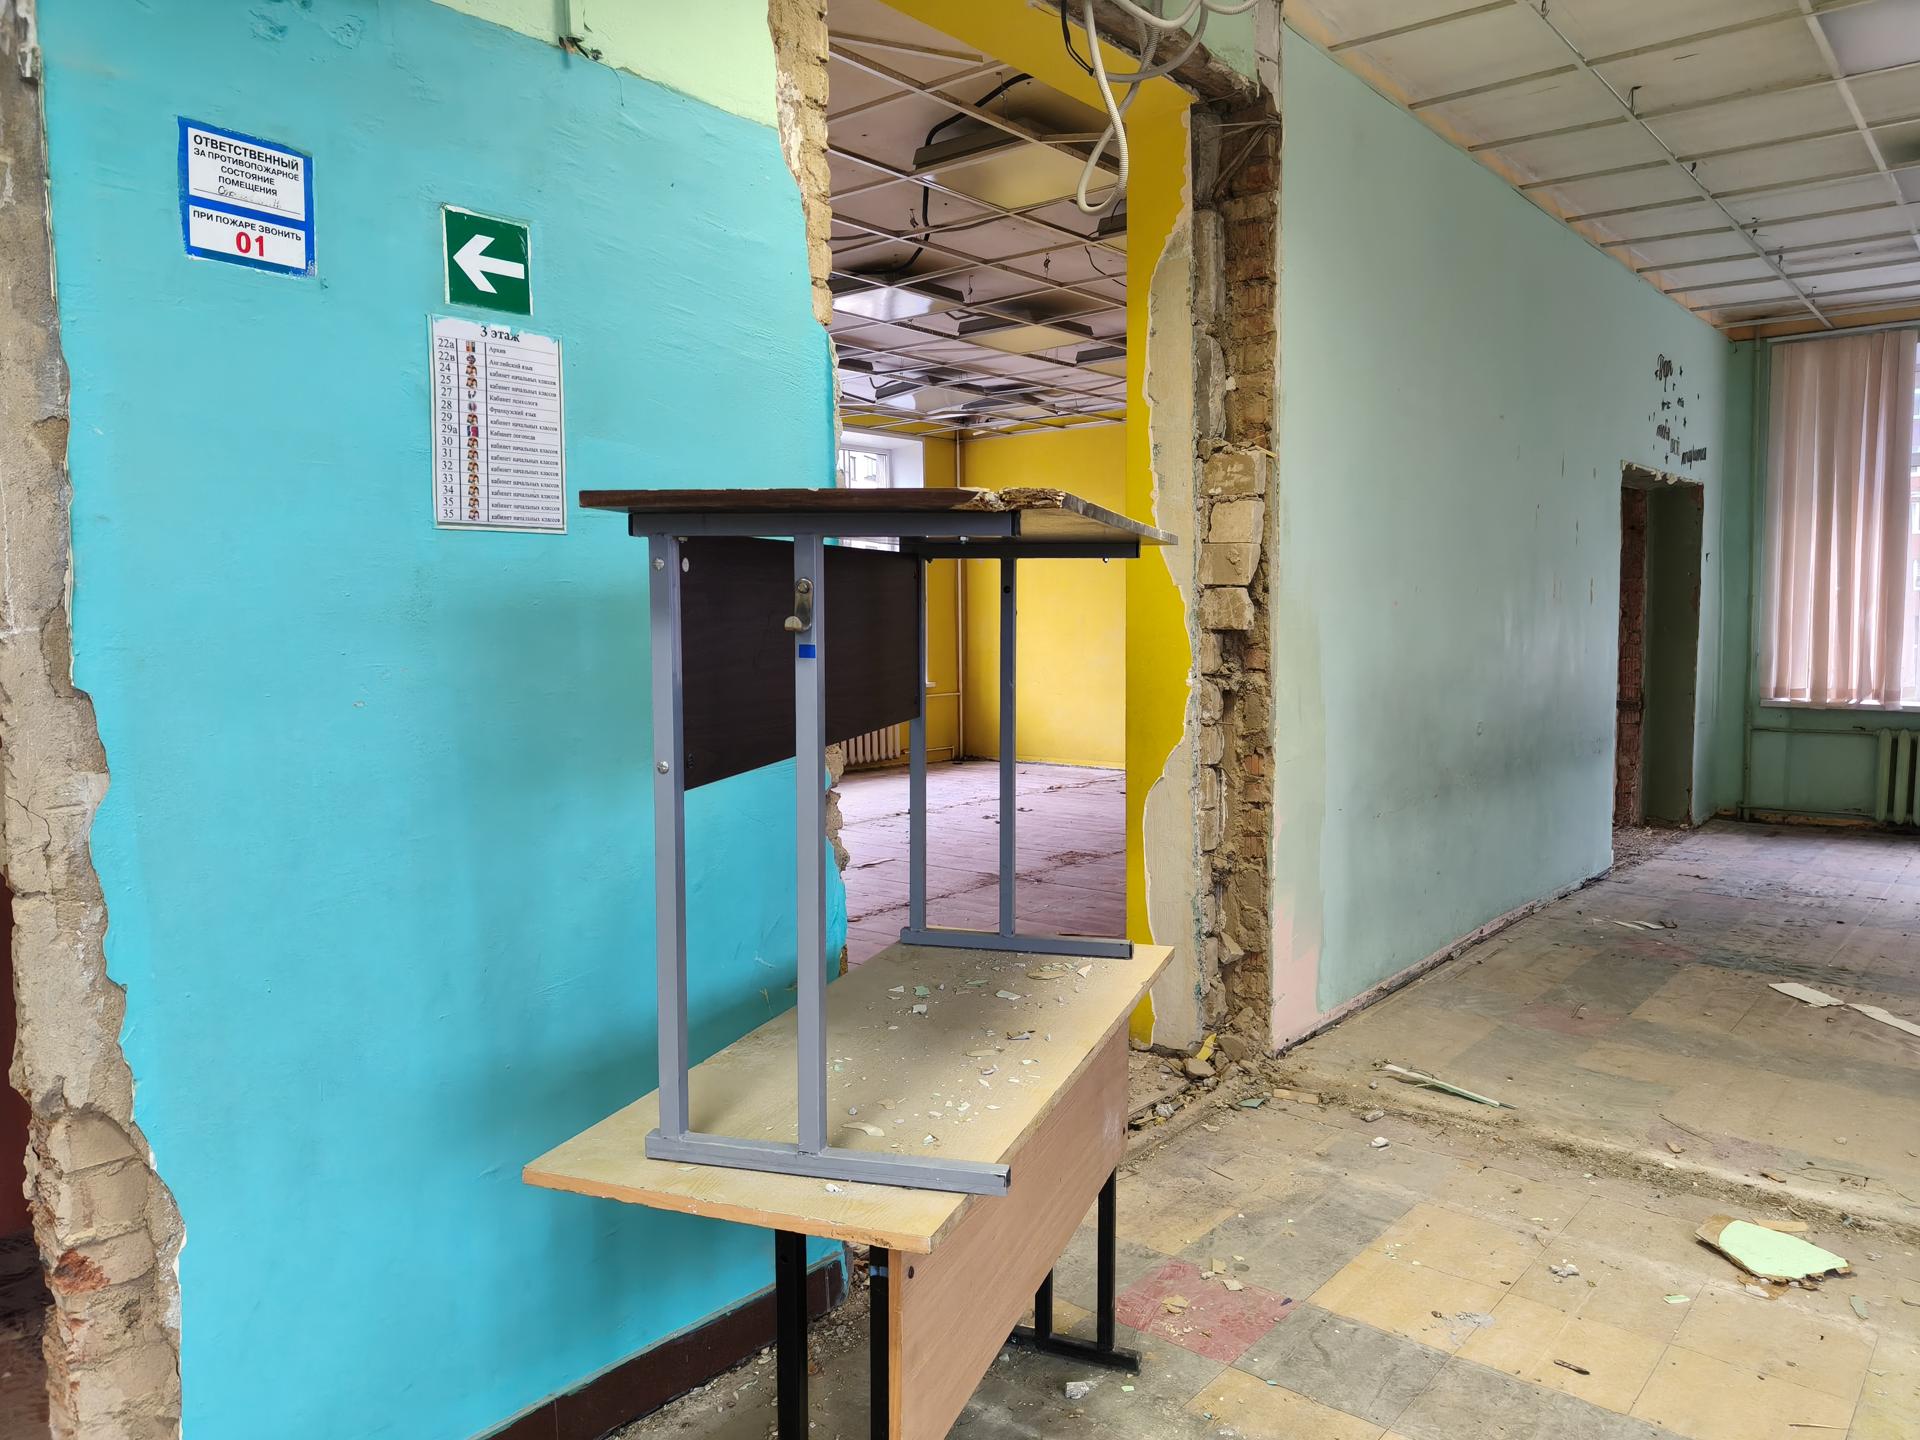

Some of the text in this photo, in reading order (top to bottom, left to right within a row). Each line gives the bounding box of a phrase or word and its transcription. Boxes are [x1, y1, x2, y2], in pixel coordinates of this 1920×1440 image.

[193, 134, 299, 171] ОТВЕТСТВЕННЫЙ
[193, 147, 300, 181] ЗА ПРОТИВОПОЖАРНОЕ
[220, 165, 276, 186] СОСТОЯНИЕ
[218, 175, 278, 197] ПОМЕЩЕНИЯ
[193, 210, 302, 241] ПРИ ПОЖАРЕ ЗВОНИТЬ
[235, 231, 265, 257] 01
[479, 325, 520, 343] 3 этаж
[439, 362, 451, 372] 24
[440, 374, 451, 384] 25
[441, 387, 452, 397] 27
[441, 399, 452, 410] 28
[441, 411, 453, 422] 29
[442, 436, 453, 446] 30
[443, 448, 452, 458] 31
[442, 460, 453, 471] 32
[442, 473, 454, 483] 33
[442, 485, 454, 495] 34
[443, 496, 454, 507] 35
[443, 508, 454, 519] 35
